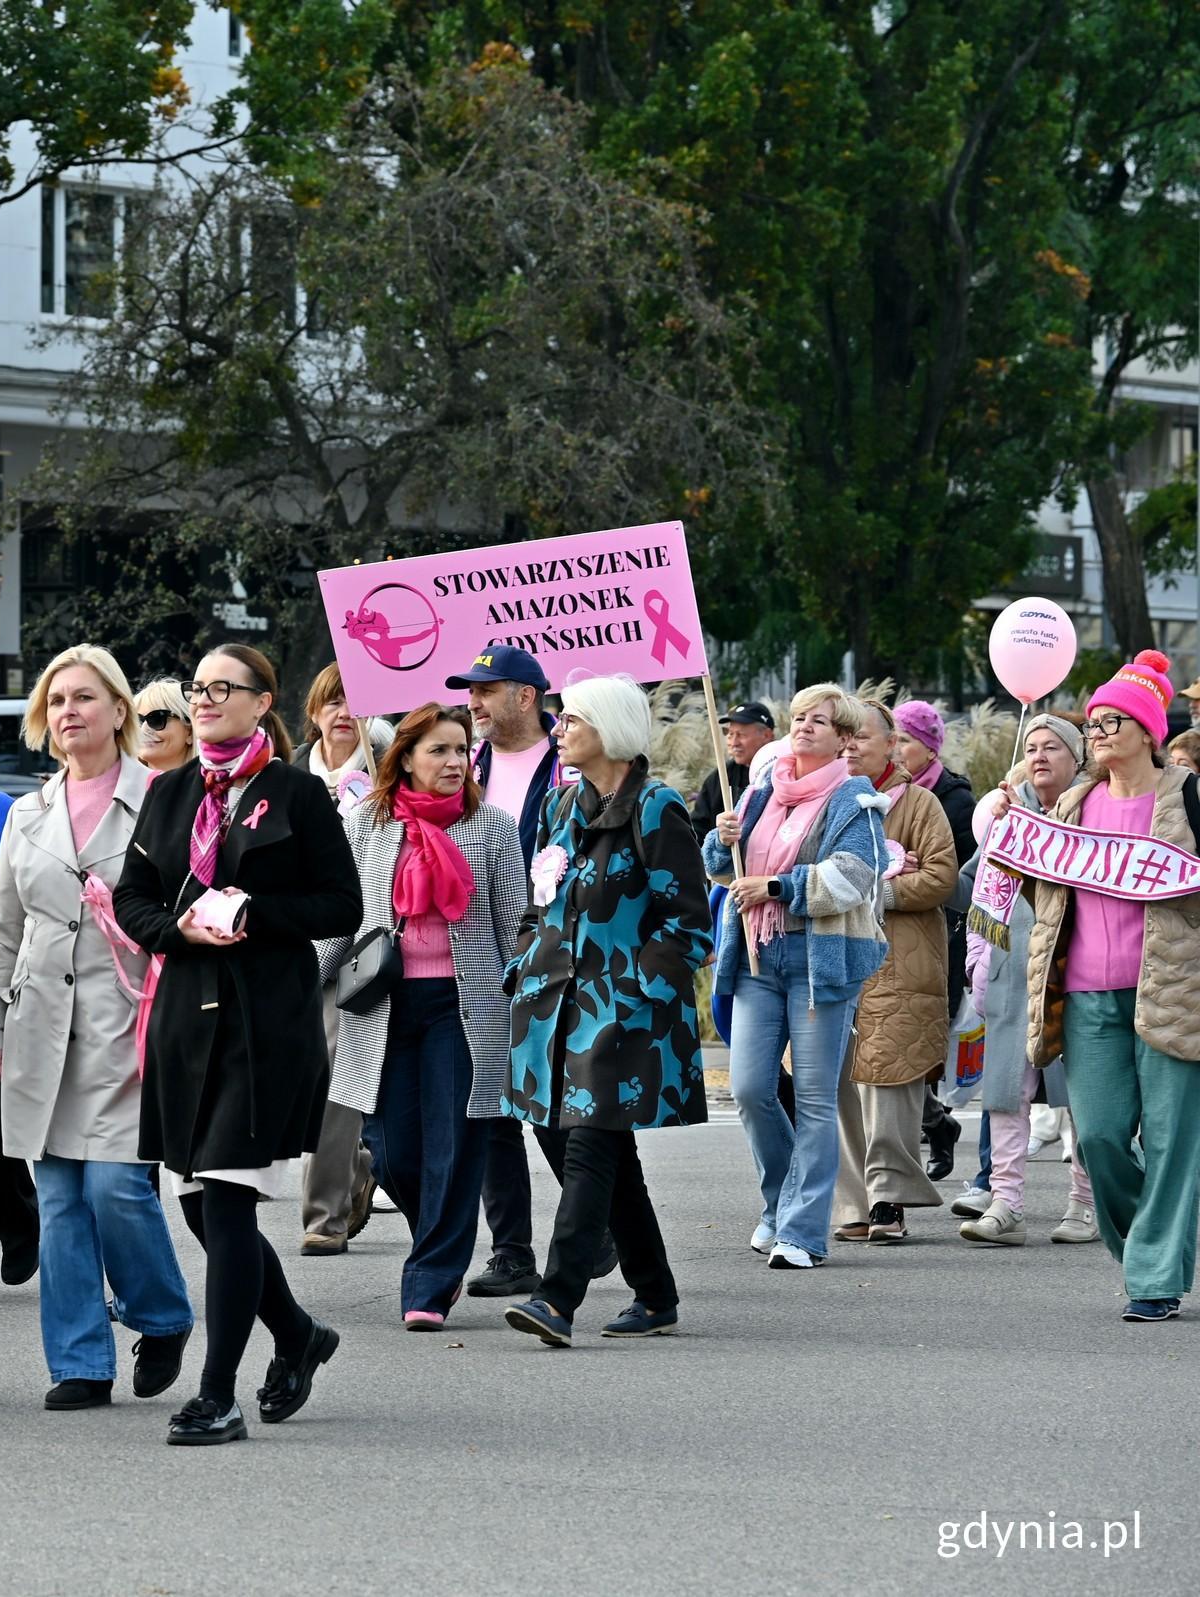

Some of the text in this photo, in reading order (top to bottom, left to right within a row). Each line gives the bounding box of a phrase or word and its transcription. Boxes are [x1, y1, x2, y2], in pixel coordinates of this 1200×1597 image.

[433, 546, 671, 597] STOWARZYSZENIE
[485, 586, 634, 625] AMAZONEK
[1020, 611, 1057, 622] GDYNIA
